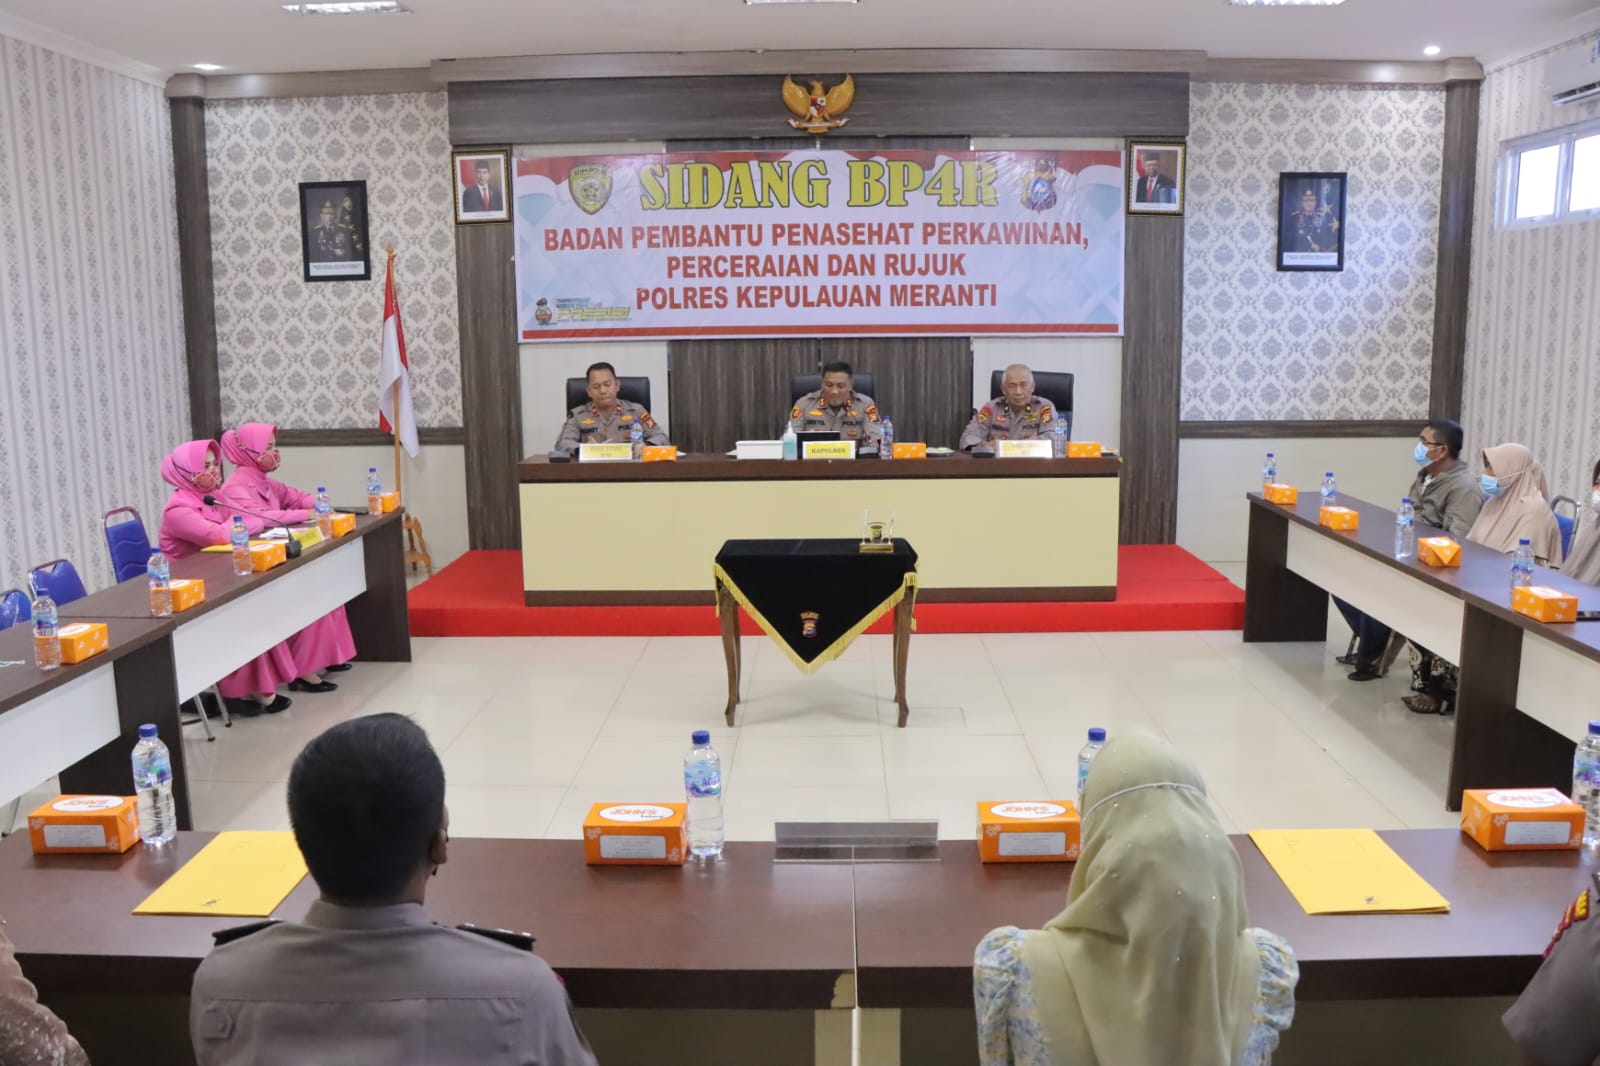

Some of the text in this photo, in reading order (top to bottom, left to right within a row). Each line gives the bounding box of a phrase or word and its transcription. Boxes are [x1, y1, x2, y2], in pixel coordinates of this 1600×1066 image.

[639, 159, 999, 210] SIDANG BP4R
[544, 222, 1089, 251] BADAN PEMBANTU PENASEHAT PERKAWINAN,
[667, 253, 967, 279] PERCERAIAN DAN RUJUK
[636, 284, 998, 311] POLRES KEPULAUAN MERANTI
